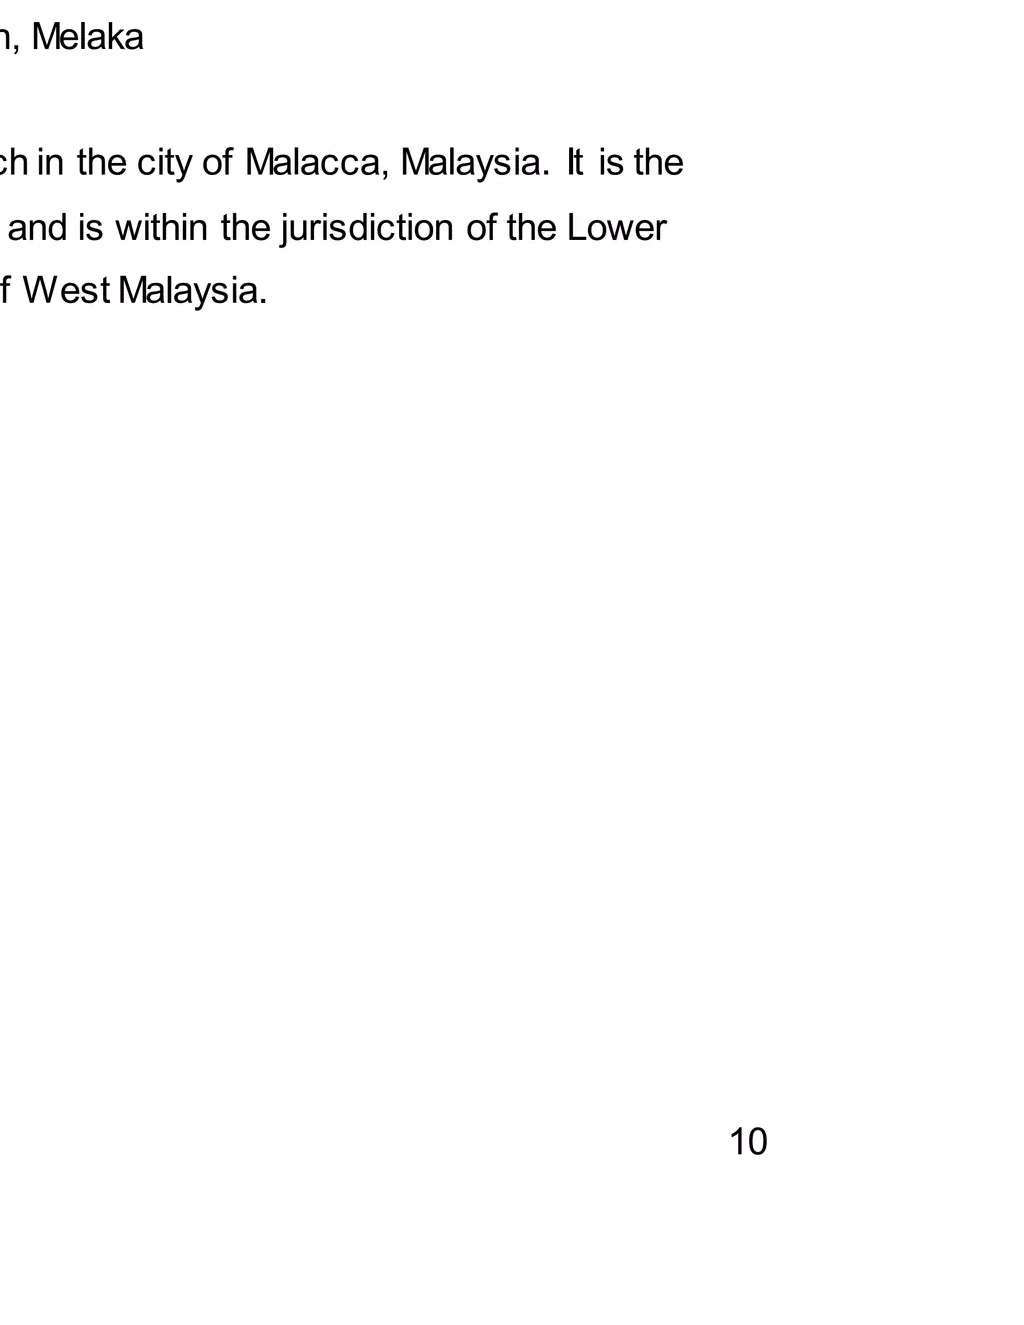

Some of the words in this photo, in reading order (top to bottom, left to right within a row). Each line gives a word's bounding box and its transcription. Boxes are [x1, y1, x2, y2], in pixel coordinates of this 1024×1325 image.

[33, 21, 144, 51] Melaka
[38, 146, 63, 176] in
[76, 146, 127, 176] the
[137, 146, 194, 184] city
[202, 146, 235, 176] of
[246, 146, 388, 181] Malacca,
[402, 146, 549, 184] Malaysia.
[568, 146, 584, 176] It
[600, 146, 624, 176] is
[633, 146, 684, 176] the
[8, 212, 67, 242] and
[79, 212, 104, 241] is
[114, 212, 207, 241] within
[220, 212, 271, 242] the
[278, 212, 453, 249] jurisdiction
[466, 211, 499, 242] of
[506, 212, 557, 242] the
[568, 212, 668, 242] Lower
[22, 275, 111, 304] West
[119, 275, 266, 312] Malaysia.
[730, 1126, 768, 1156] 10
